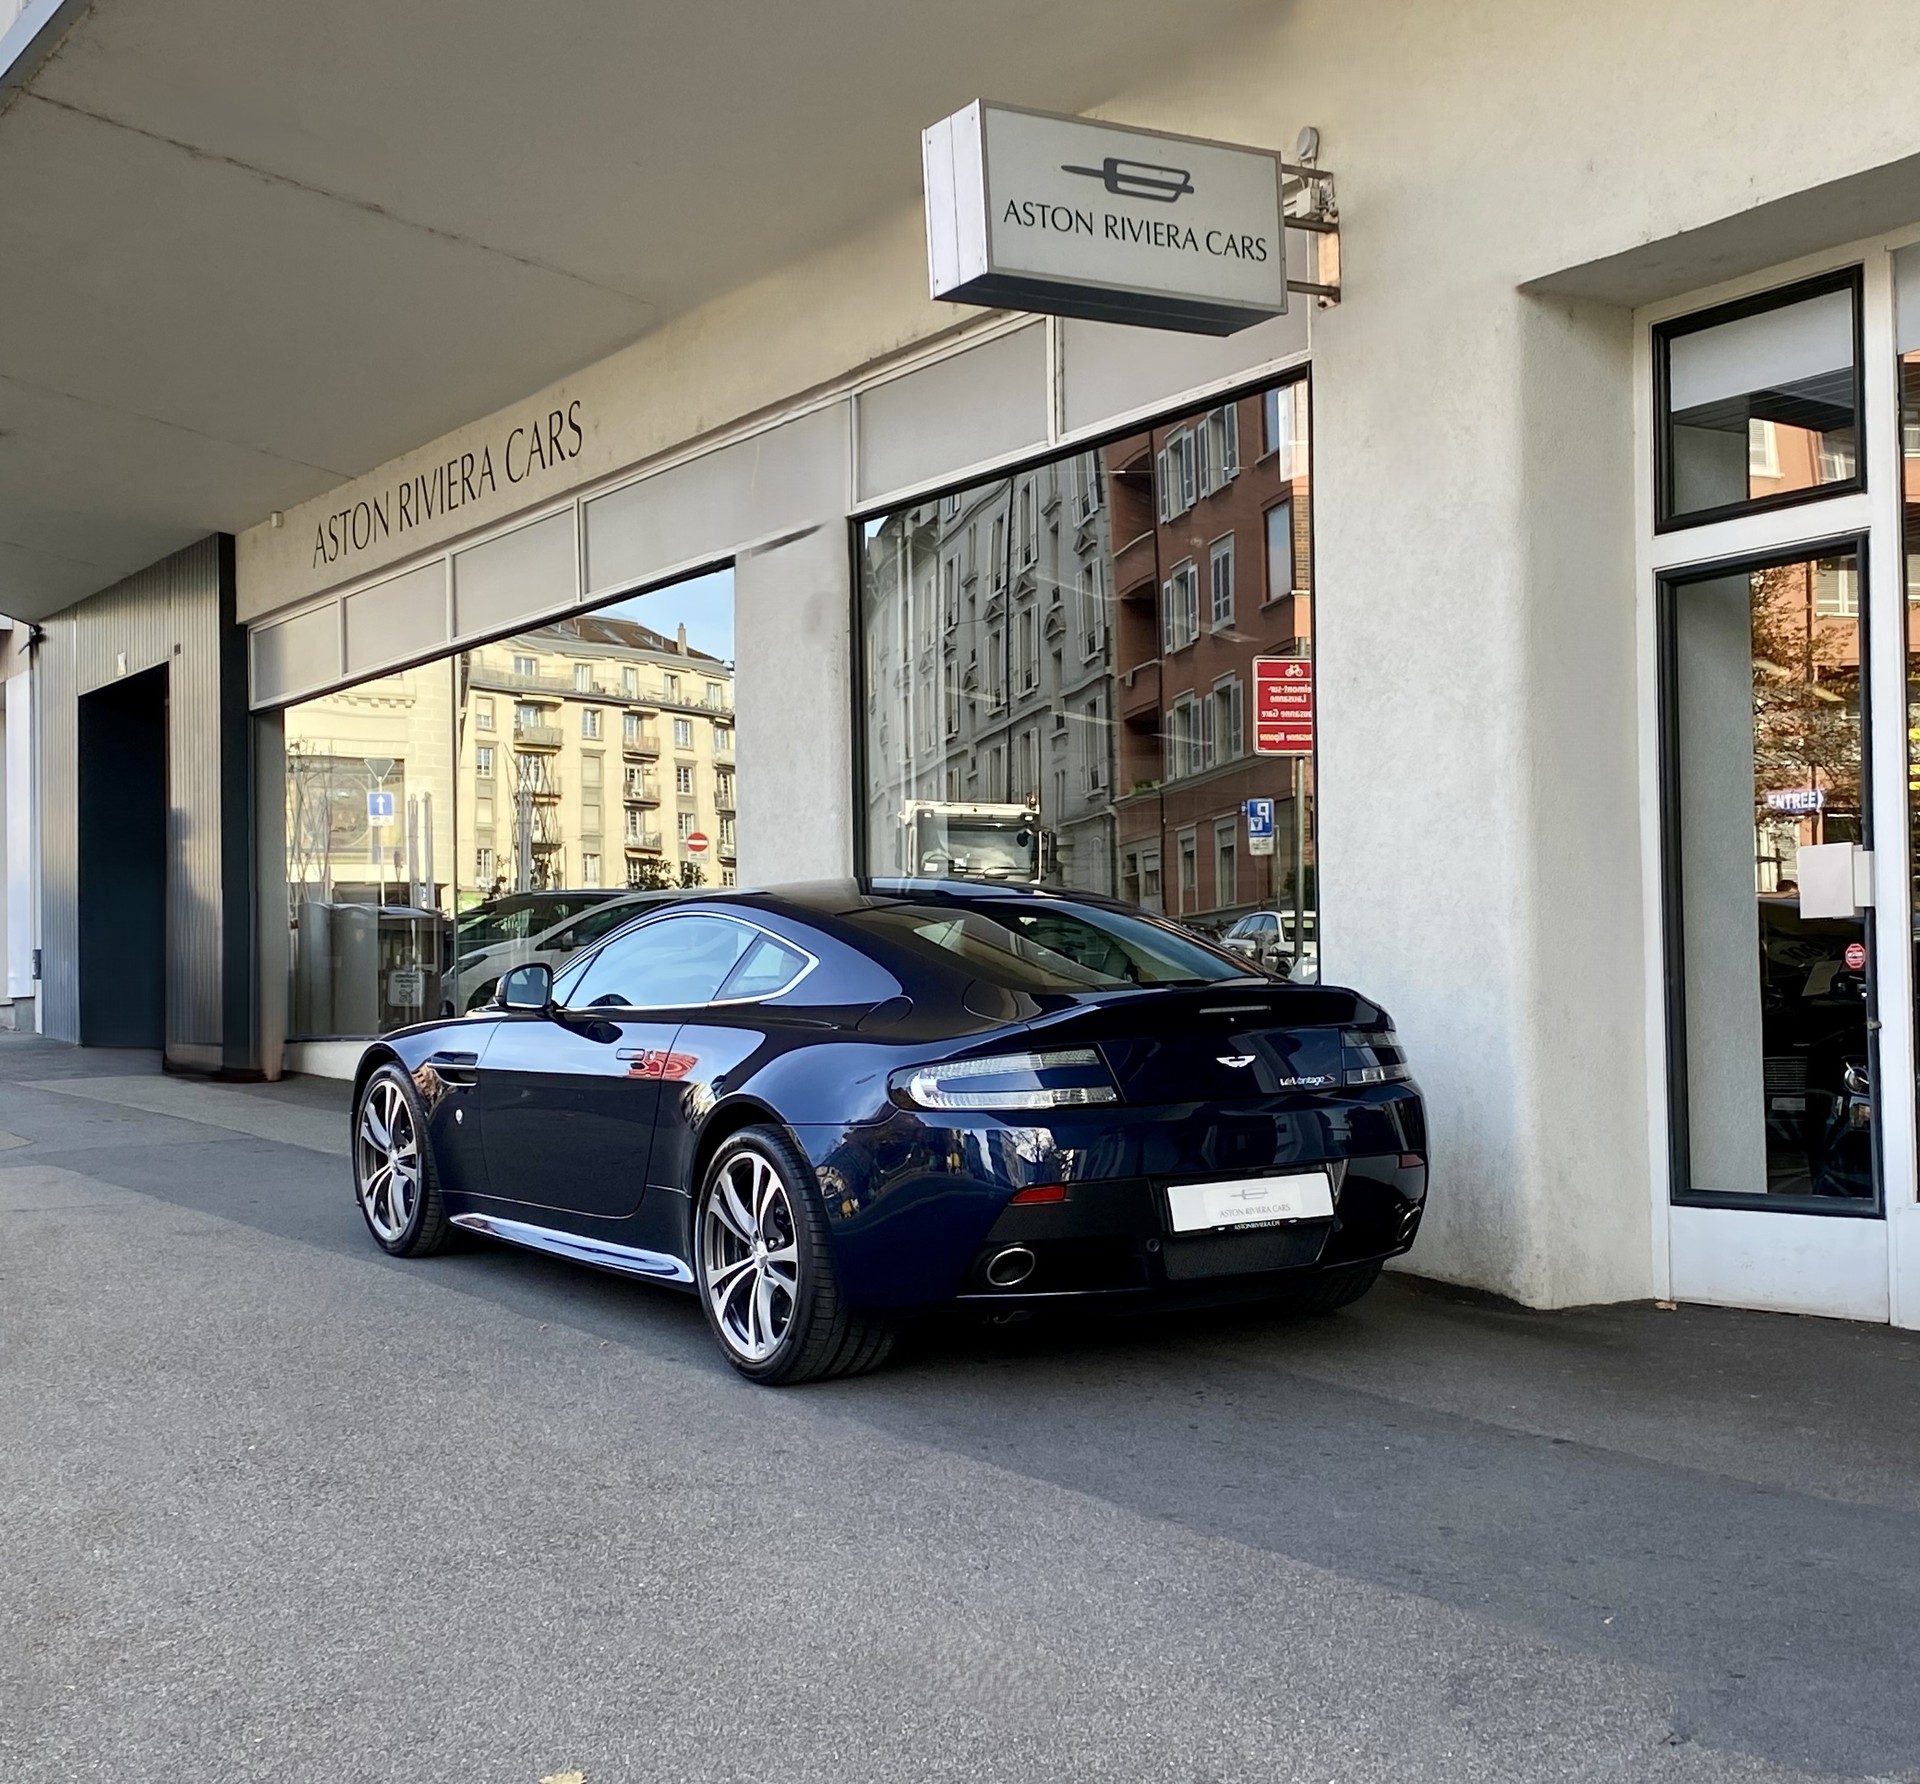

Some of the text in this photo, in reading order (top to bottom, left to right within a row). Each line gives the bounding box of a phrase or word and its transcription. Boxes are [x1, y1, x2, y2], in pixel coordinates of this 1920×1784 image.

[1003, 199, 1268, 262] ASTON RIVIERA CARS
[313, 400, 583, 568] ASTON RIVIERA CARS
[1767, 791, 1816, 810] ENTREE
[1219, 1203, 1291, 1218] ASTON RIVIERA CARS
